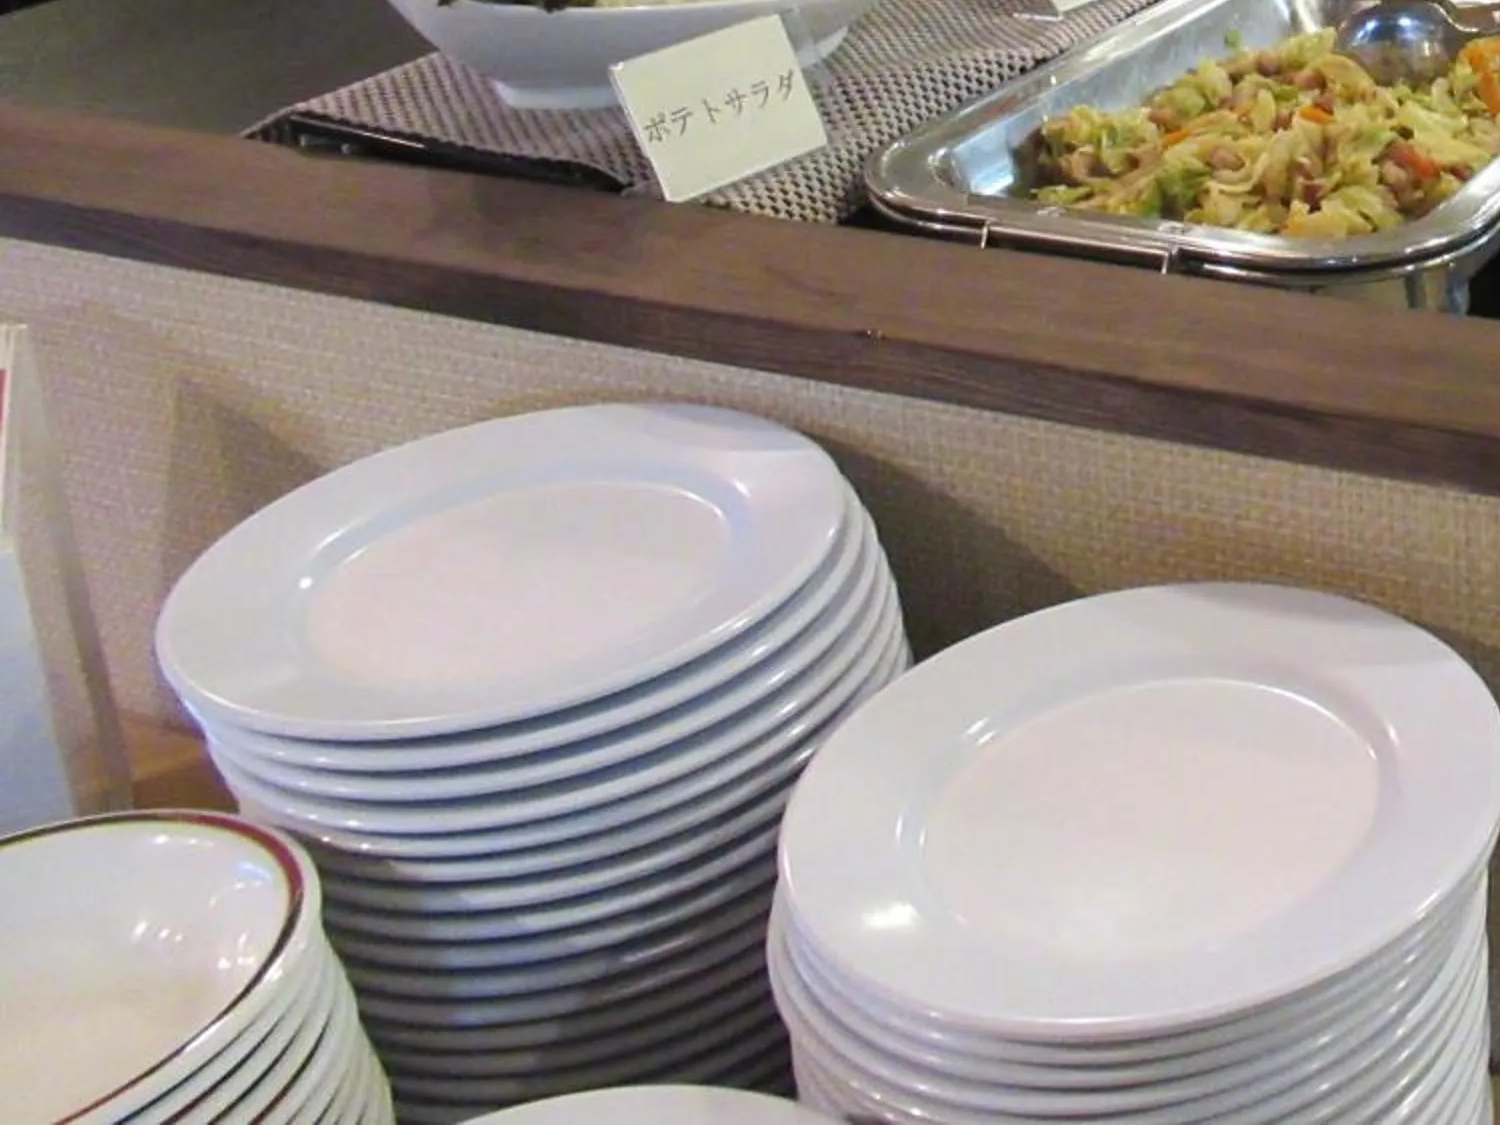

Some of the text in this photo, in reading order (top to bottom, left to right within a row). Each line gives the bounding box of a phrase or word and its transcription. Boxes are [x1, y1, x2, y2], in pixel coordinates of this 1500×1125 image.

[643, 69, 794, 143] ポテトサラダ
